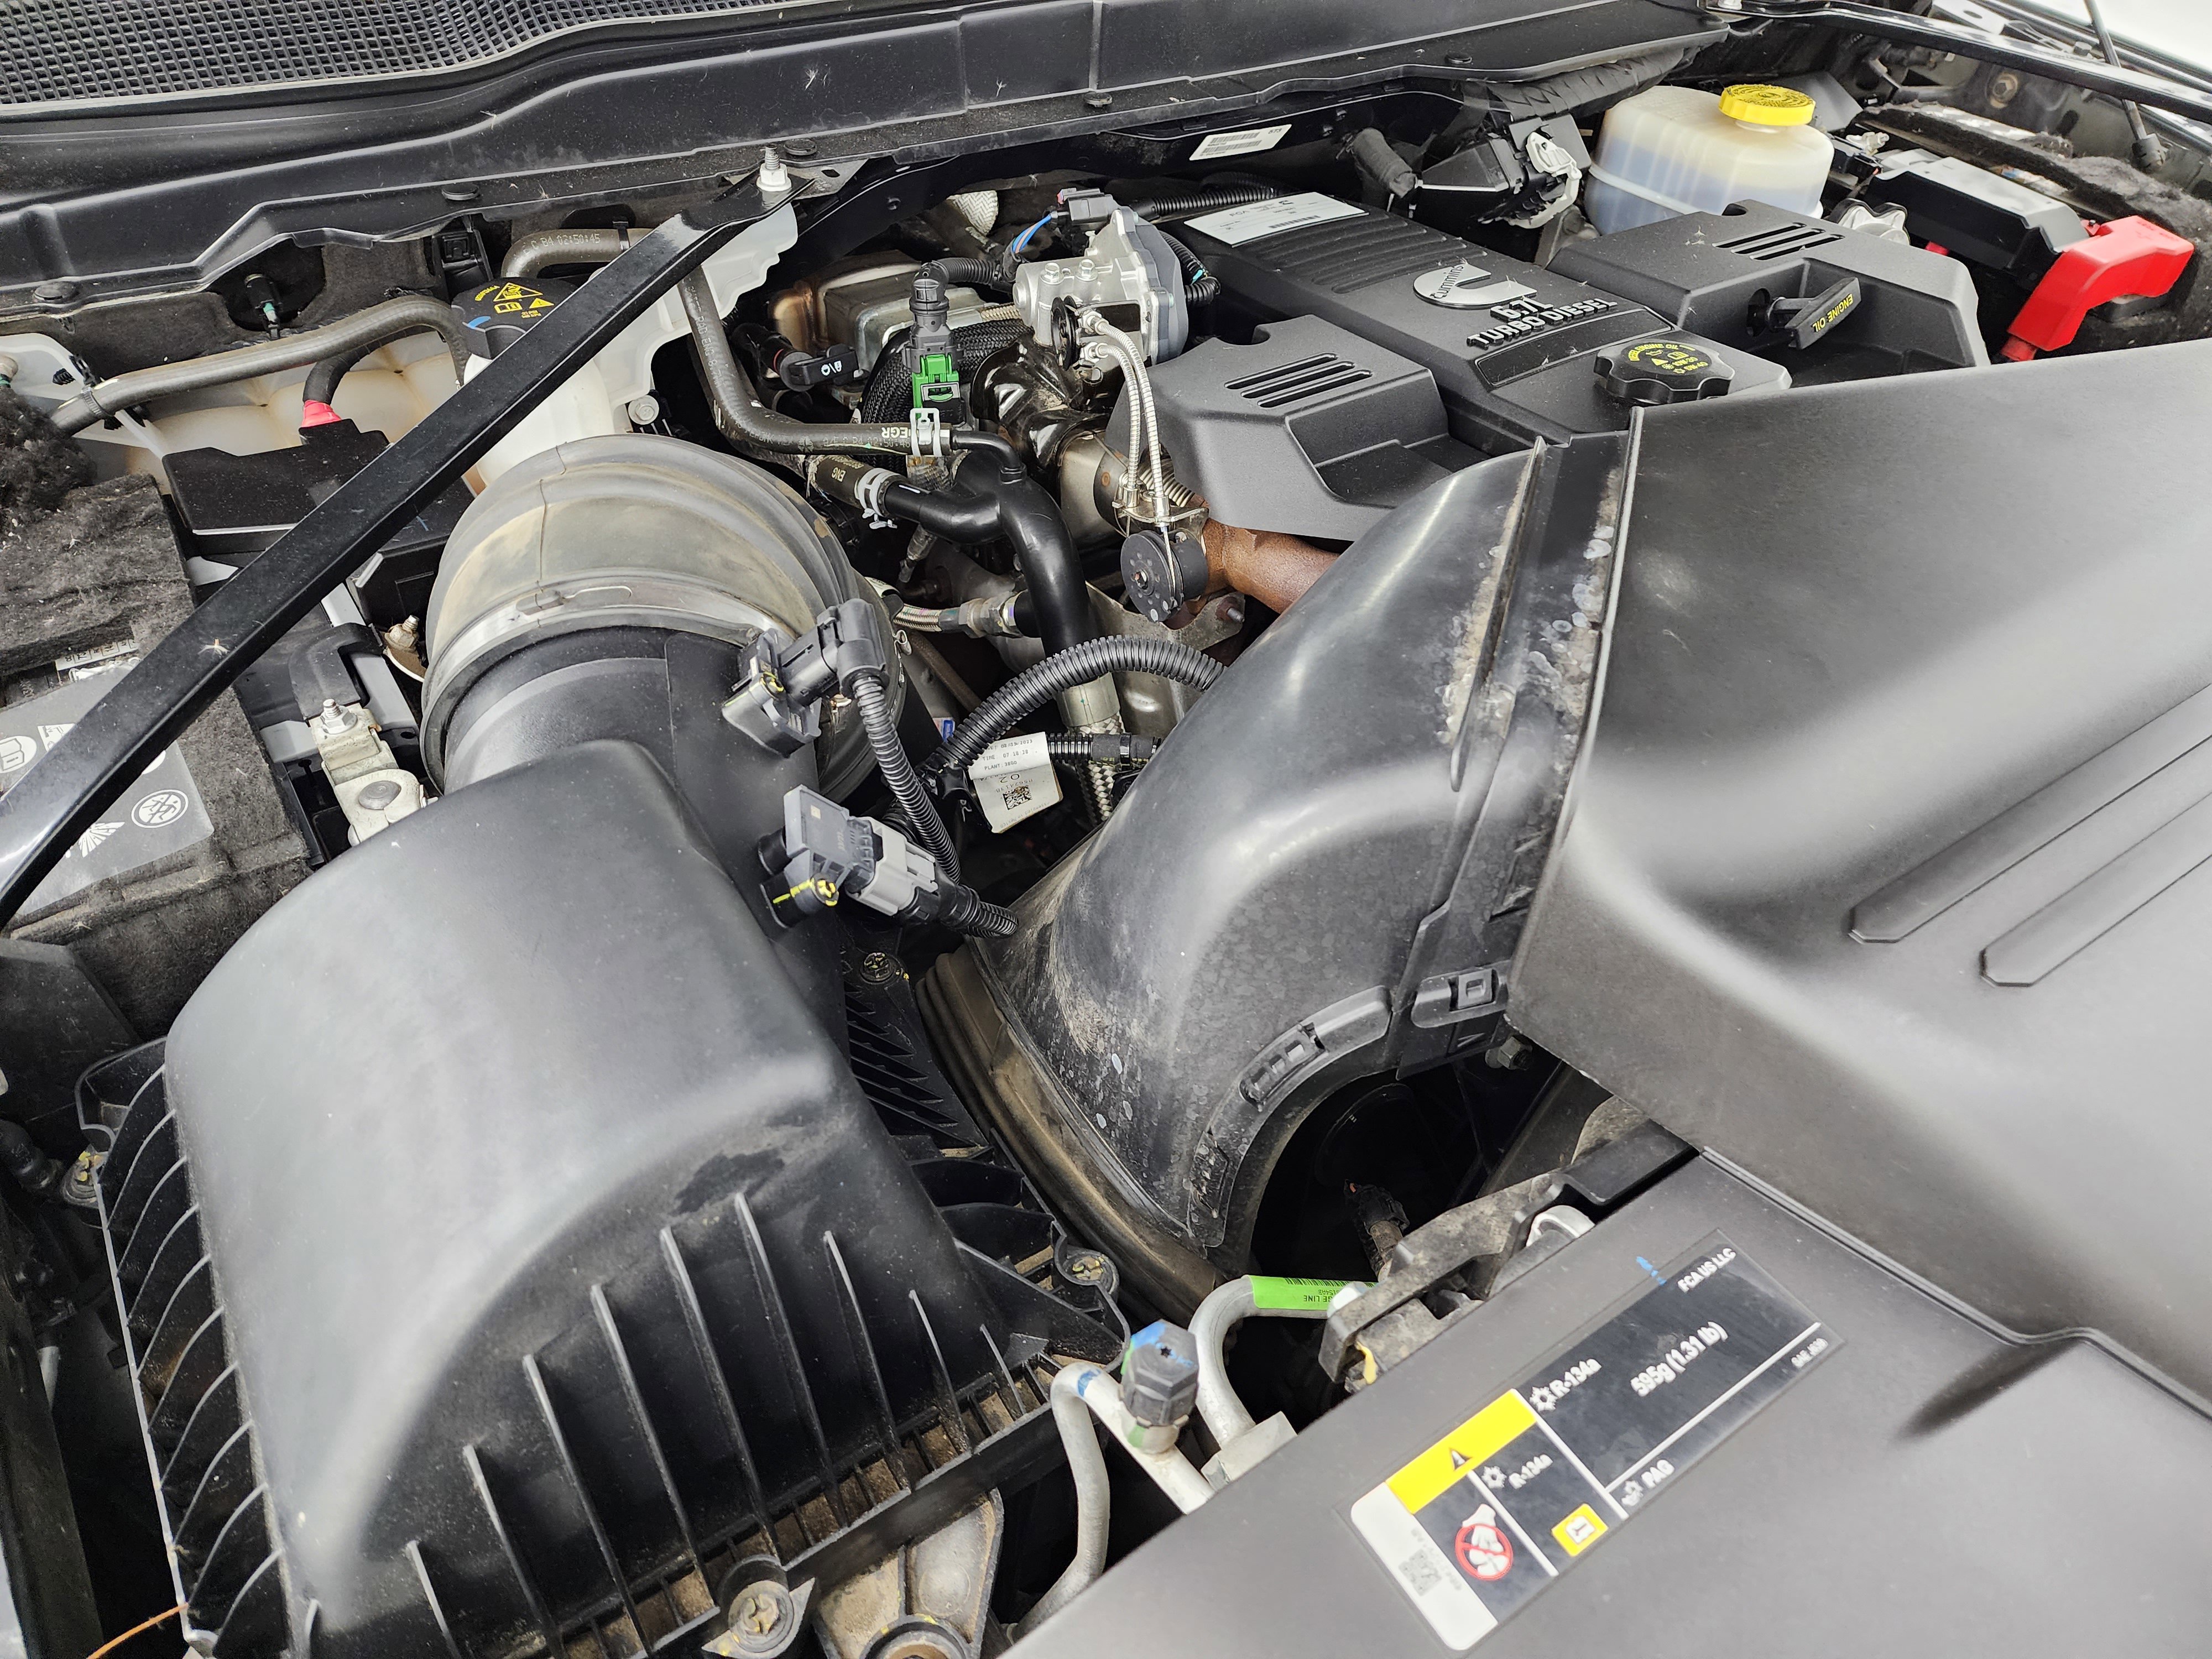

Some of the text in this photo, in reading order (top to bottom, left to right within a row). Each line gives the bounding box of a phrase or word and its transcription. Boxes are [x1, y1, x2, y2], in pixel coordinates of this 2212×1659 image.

[1467, 298, 1618, 349] TURBO DIESEL
[1490, 297, 1554, 322] 6.7L
[1812, 293, 1854, 332] ENGINE OIL
[831, 467, 847, 482] ENG
[1697, 1261, 1718, 1277] US
[1711, 1248, 1736, 1269] LLC
[1630, 1321, 1729, 1397] 595g (1.31 lb)
[1549, 1358, 1603, 1399] R-134a
[1508, 1453, 1554, 1490] R-134a
[1640, 1459, 1675, 1489] PAG
